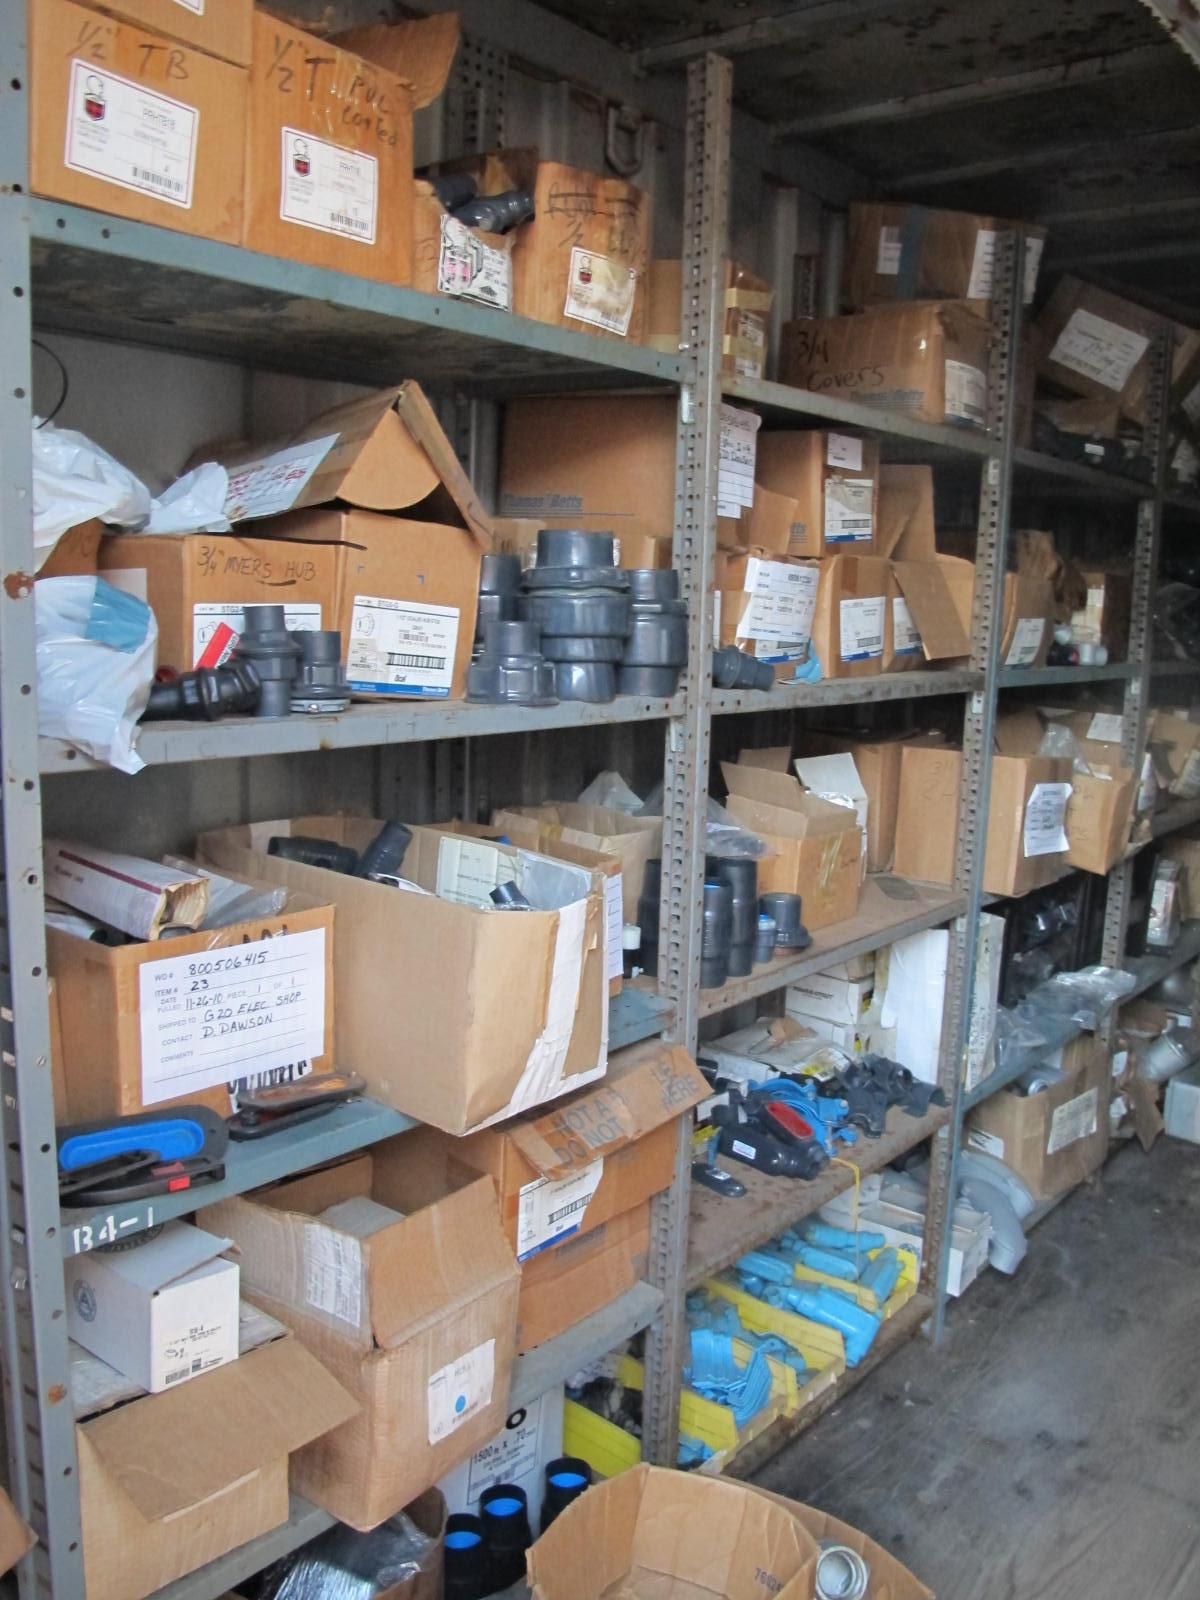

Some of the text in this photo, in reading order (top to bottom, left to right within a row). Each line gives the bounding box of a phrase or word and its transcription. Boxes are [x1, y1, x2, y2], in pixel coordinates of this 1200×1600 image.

[285, 561, 316, 582] HUB
[154, 988, 172, 998] ITEM
[190, 979, 210, 991] 23
[237, 1000, 266, 1014] ELEC
[275, 991, 302, 1007] SHOP
[220, 1013, 273, 1035] DAWSON
[161, 1033, 193, 1046] CONTACT
[72, 1206, 154, 1255] B4-1
